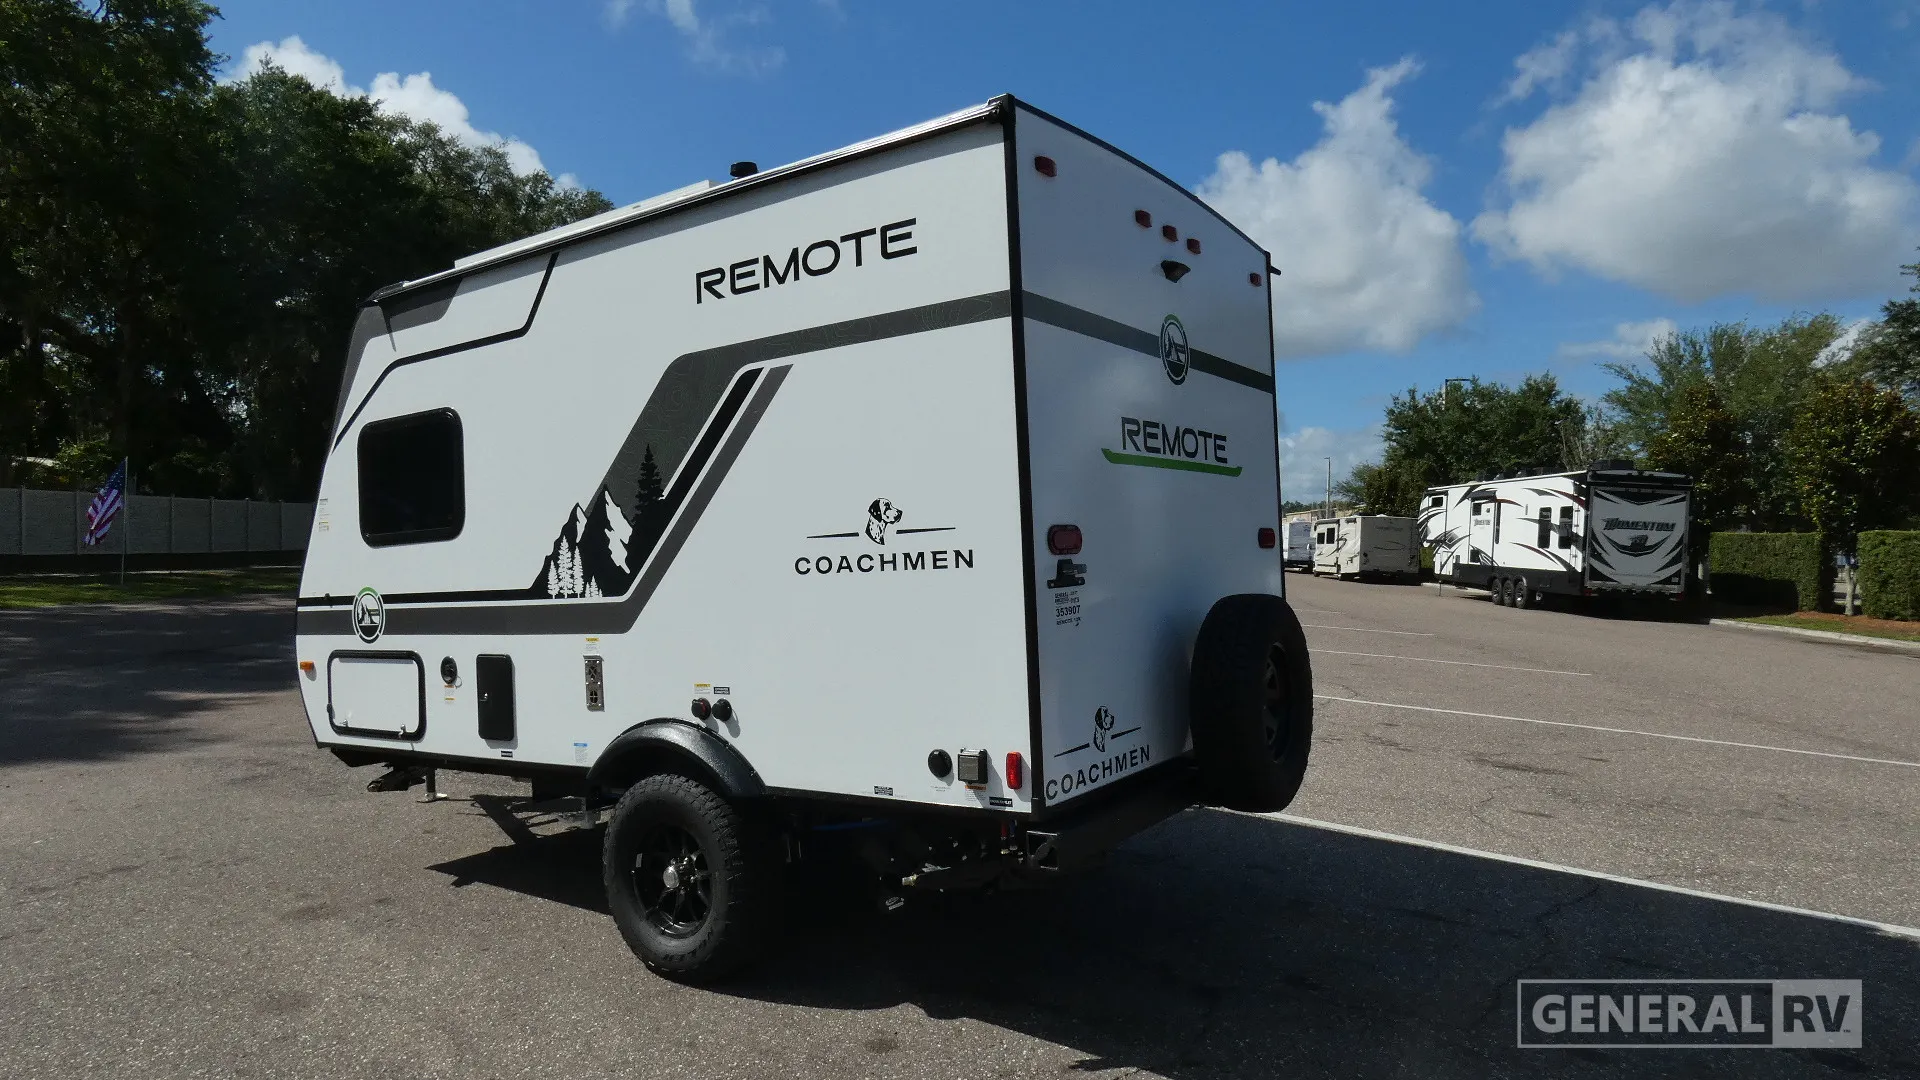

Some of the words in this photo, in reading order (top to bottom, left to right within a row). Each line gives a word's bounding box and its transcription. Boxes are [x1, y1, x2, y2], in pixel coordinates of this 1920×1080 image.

[695, 217, 918, 305] REMOTE
[1120, 416, 1228, 463] REMOTE
[794, 549, 974, 575] COACHMEN
[1056, 605, 1080, 617] 353907
[1045, 744, 1151, 801] COACHMEN
